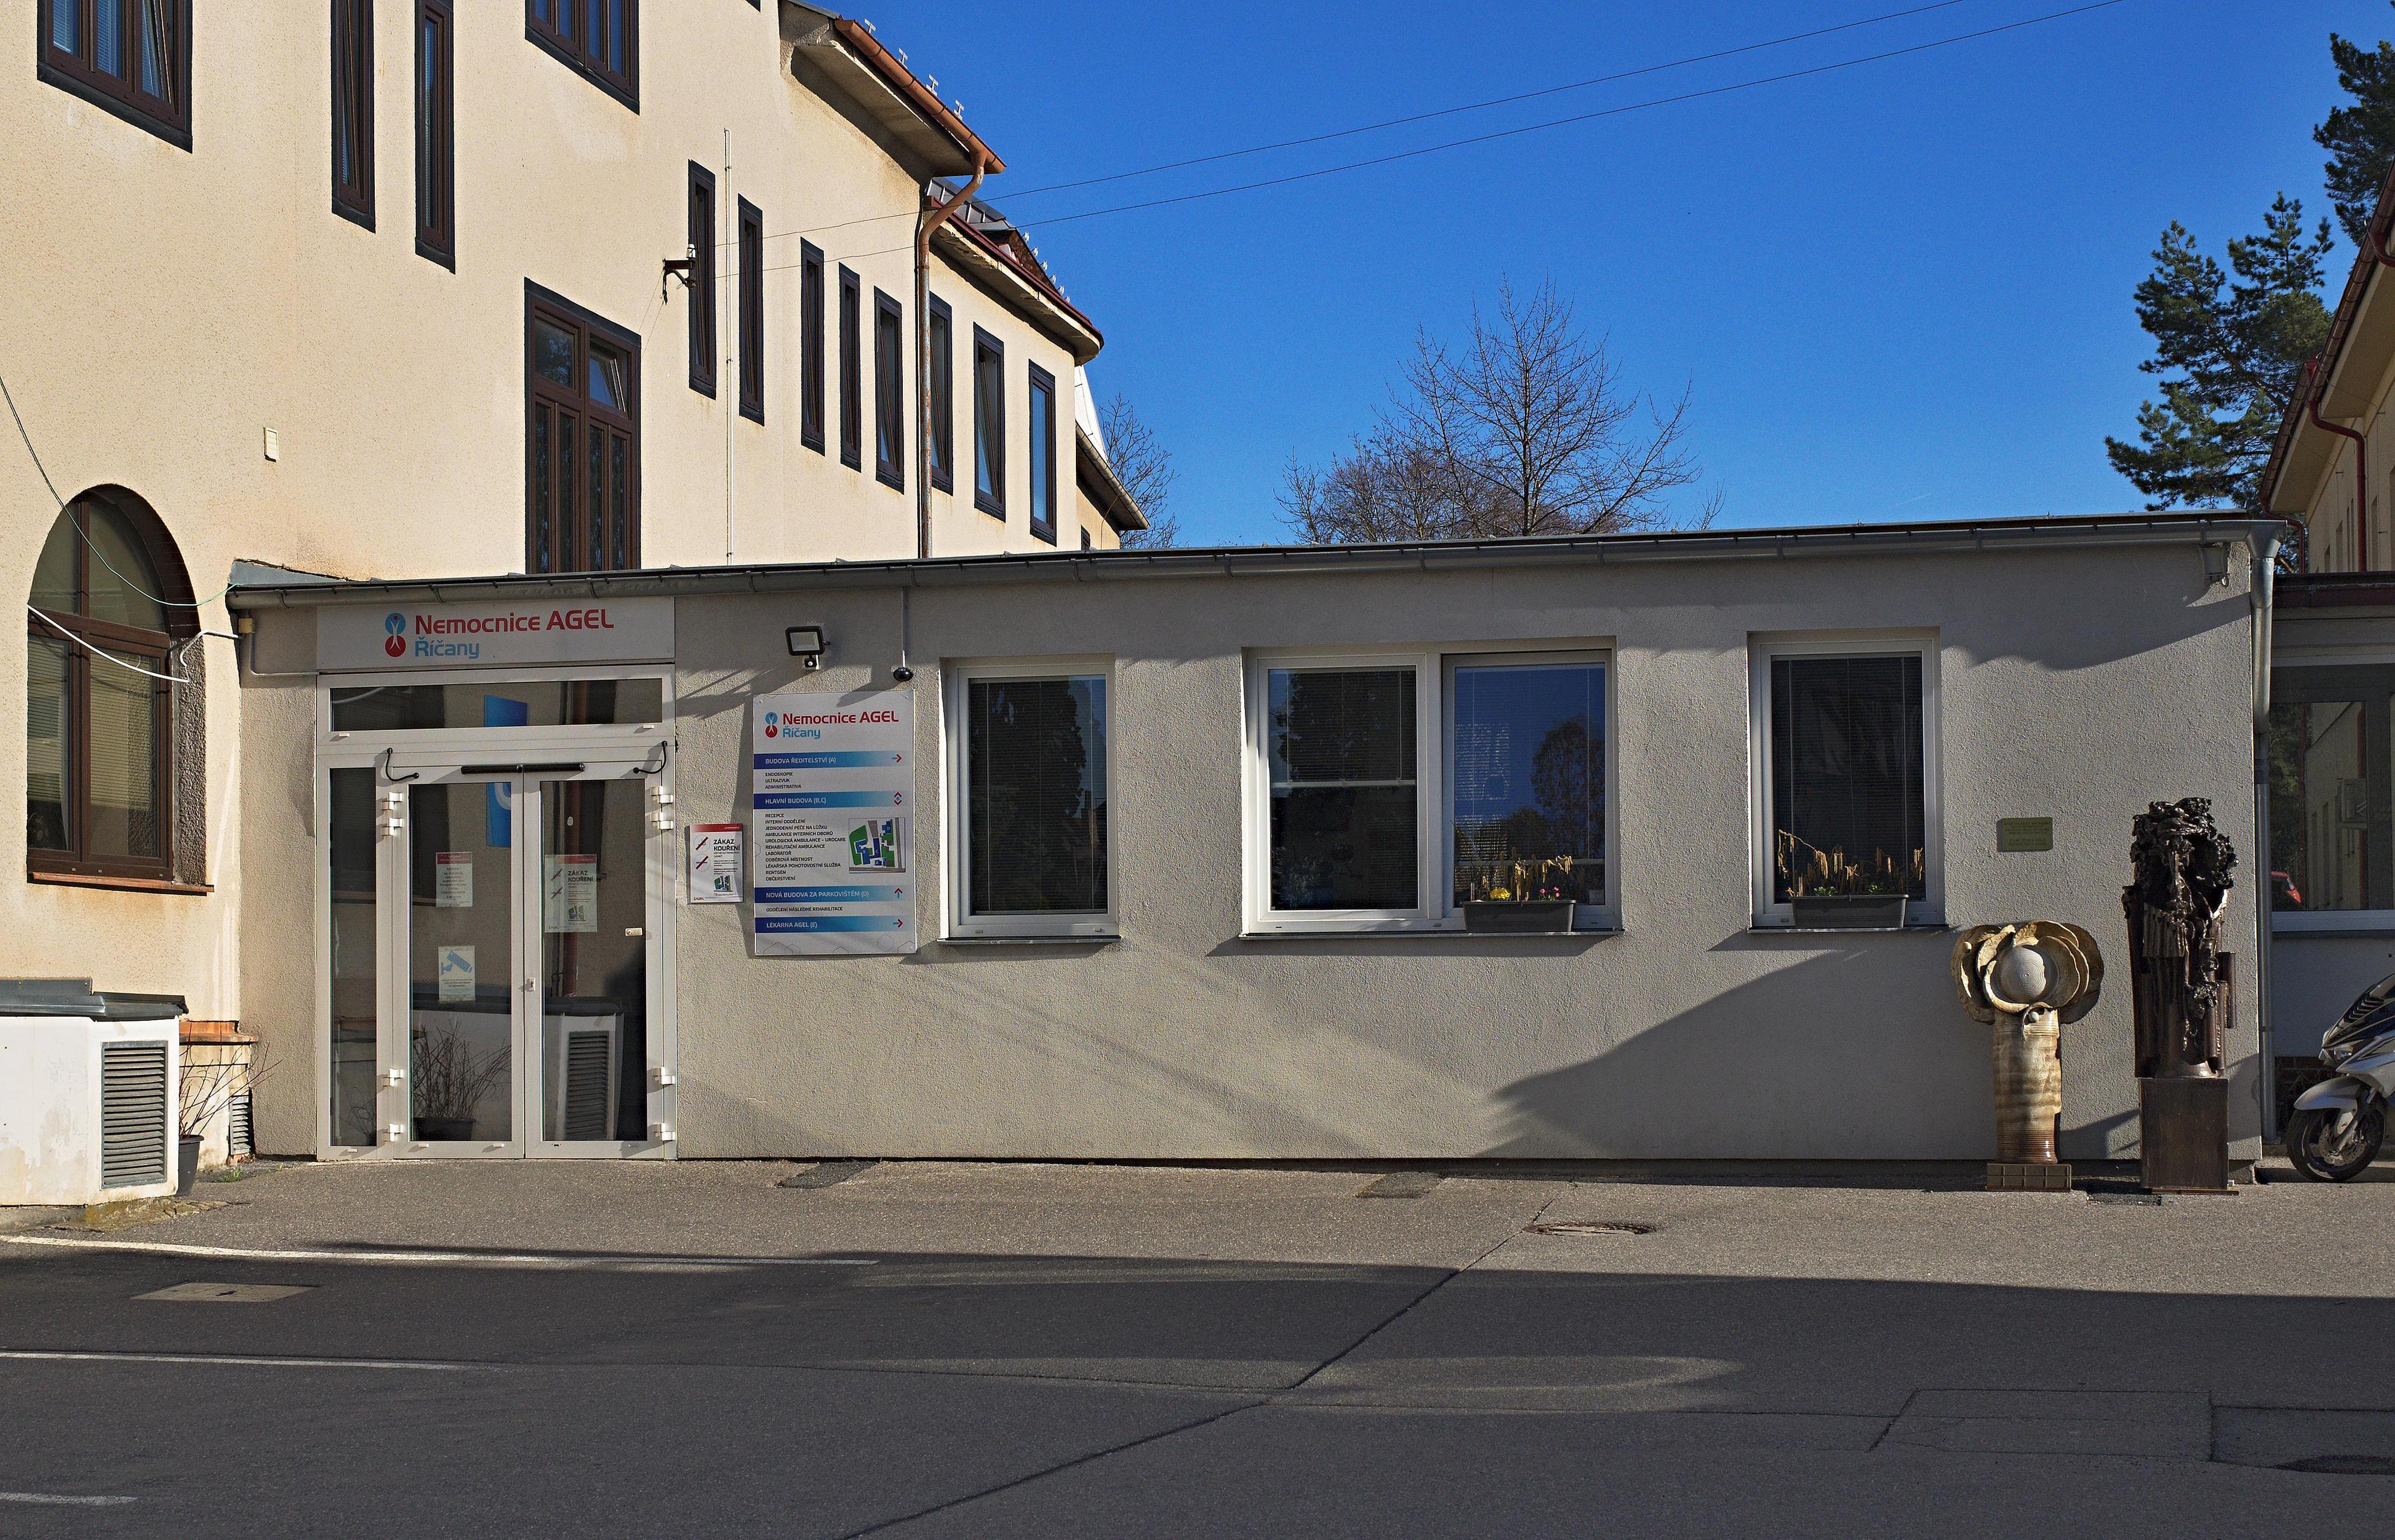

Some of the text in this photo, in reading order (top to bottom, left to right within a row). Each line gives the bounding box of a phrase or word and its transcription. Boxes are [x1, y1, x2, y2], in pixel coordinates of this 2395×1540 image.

[415, 609, 614, 635] Nemocnice AGEL
[415, 637, 480, 659] Říčany
[783, 711, 899, 725] Nemocnice AGEL
[783, 727, 821, 739] Říčany
